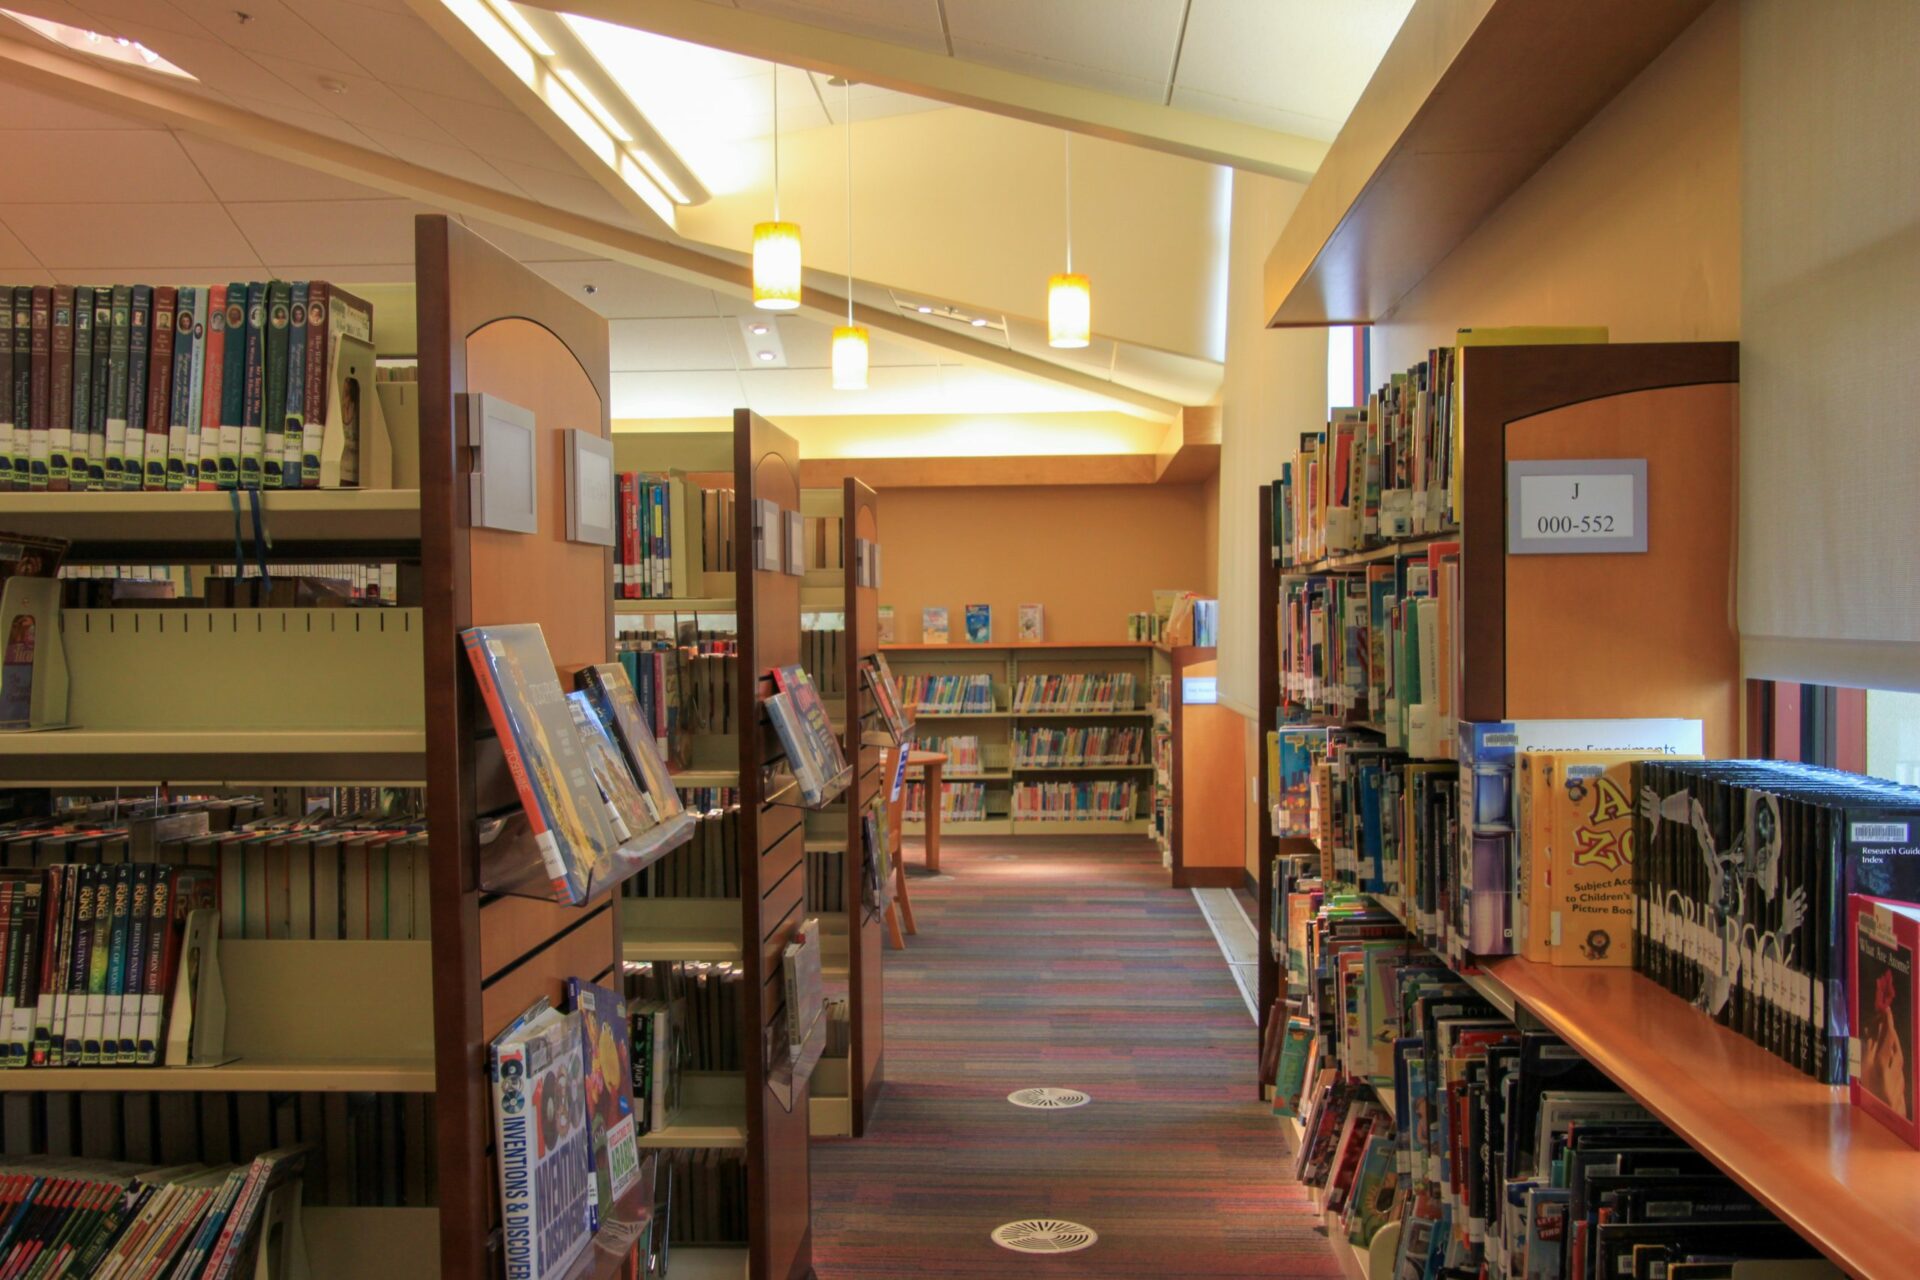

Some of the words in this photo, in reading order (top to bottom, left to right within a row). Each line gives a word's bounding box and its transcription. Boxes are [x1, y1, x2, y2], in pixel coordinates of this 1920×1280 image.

[1571, 483, 1581, 500] J
[1537, 515, 1615, 534] 000-552
[1589, 777, 1633, 826] A
[1862, 846, 1897, 855] Research
[1862, 856, 1884, 864] Index
[1574, 881, 1612, 892] Subject
[1580, 892, 1630, 902] Children's
[78, 886, 91, 921] RING
[95, 884, 107, 918] RING
[113, 883, 125, 917] RING
[132, 884, 145, 917] RING
[152, 883, 165, 917] RING
[1572, 904, 1609, 913] Picture
[113, 928, 121, 949] CAVE
[132, 922, 141, 955] BEHIND
[151, 931, 160, 949] THE
[75, 936, 85, 968] MUTINY
[112, 951, 119, 964] OF
[149, 949, 158, 971] IRON
[74, 972, 82, 981] IN
[129, 956, 138, 987] ENEMY
[503, 1117, 528, 1198] INVENTIONS
[535, 1127, 588, 1235] INVENTIONS
[507, 1203, 527, 1213] &
